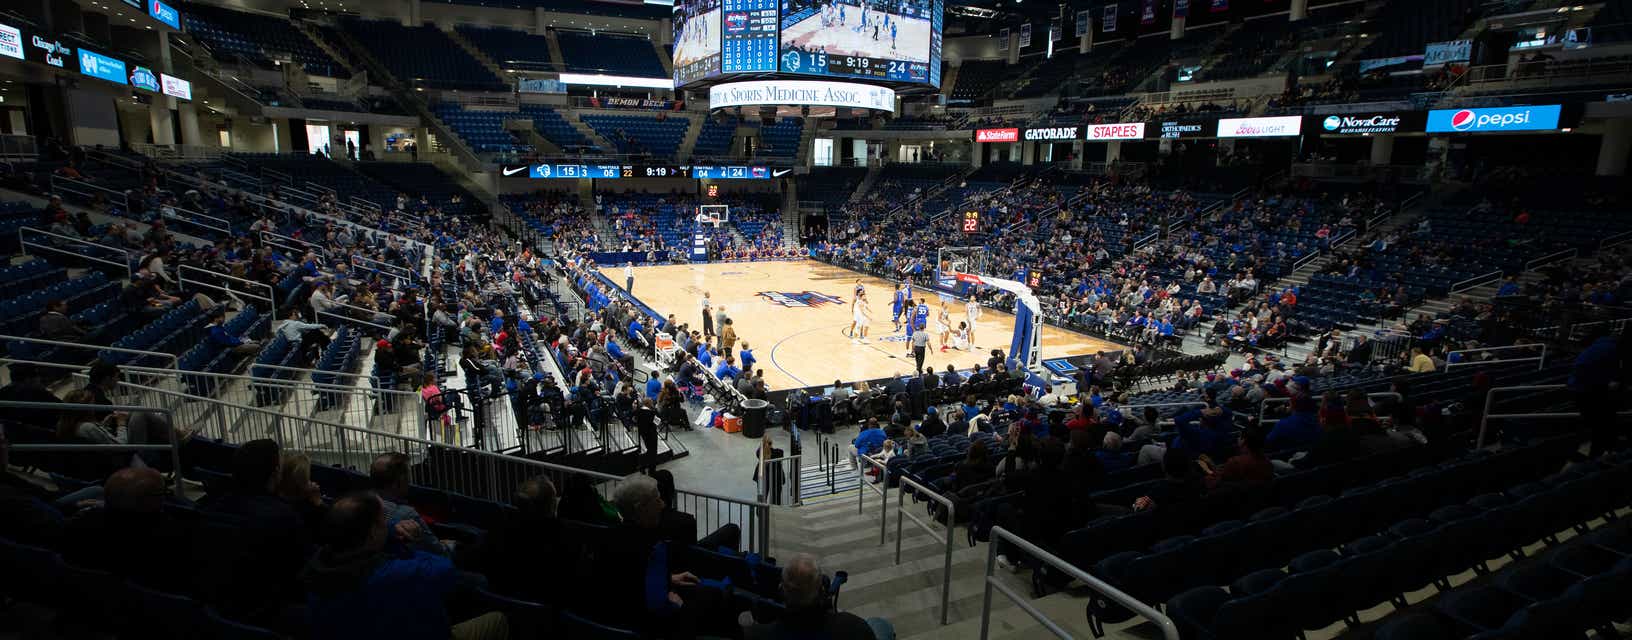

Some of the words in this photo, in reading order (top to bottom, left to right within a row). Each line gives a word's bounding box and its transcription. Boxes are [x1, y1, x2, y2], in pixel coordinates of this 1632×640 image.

[810, 54, 826, 67] 15
[846, 56, 869, 68] 9:19
[888, 61, 906, 74] 24
[730, 87, 762, 102] SPORTS
[766, 86, 819, 102] MEDICINE
[824, 88, 861, 104] ASSOC.
[607, 98, 640, 106] DEMON
[1341, 117, 1400, 128] NovaCare
[1477, 110, 1530, 128] pepsi
[1025, 128, 1078, 140] GATORADE
[1093, 126, 1137, 138] STAPLES
[563, 167, 574, 176] 15
[646, 168, 666, 176] 9:19
[733, 168, 742, 176] 24
[964, 219, 977, 231] 22
[1031, 278, 1040, 286] 22
